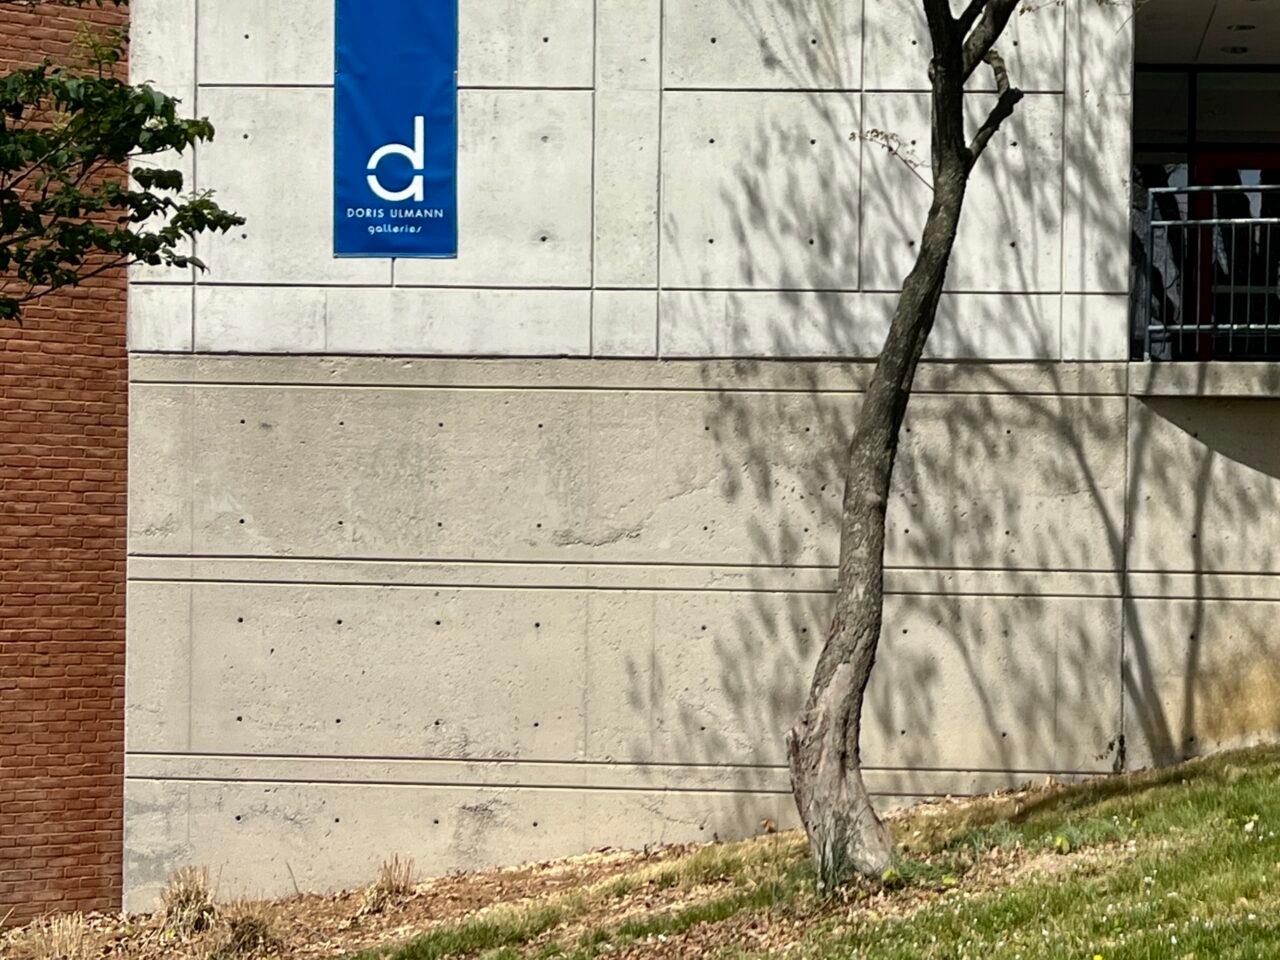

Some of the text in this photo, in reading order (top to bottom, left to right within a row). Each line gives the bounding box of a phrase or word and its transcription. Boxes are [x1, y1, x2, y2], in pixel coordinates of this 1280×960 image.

[346, 208, 444, 218] DORIS ULMANN
[367, 224, 423, 235] galleries
